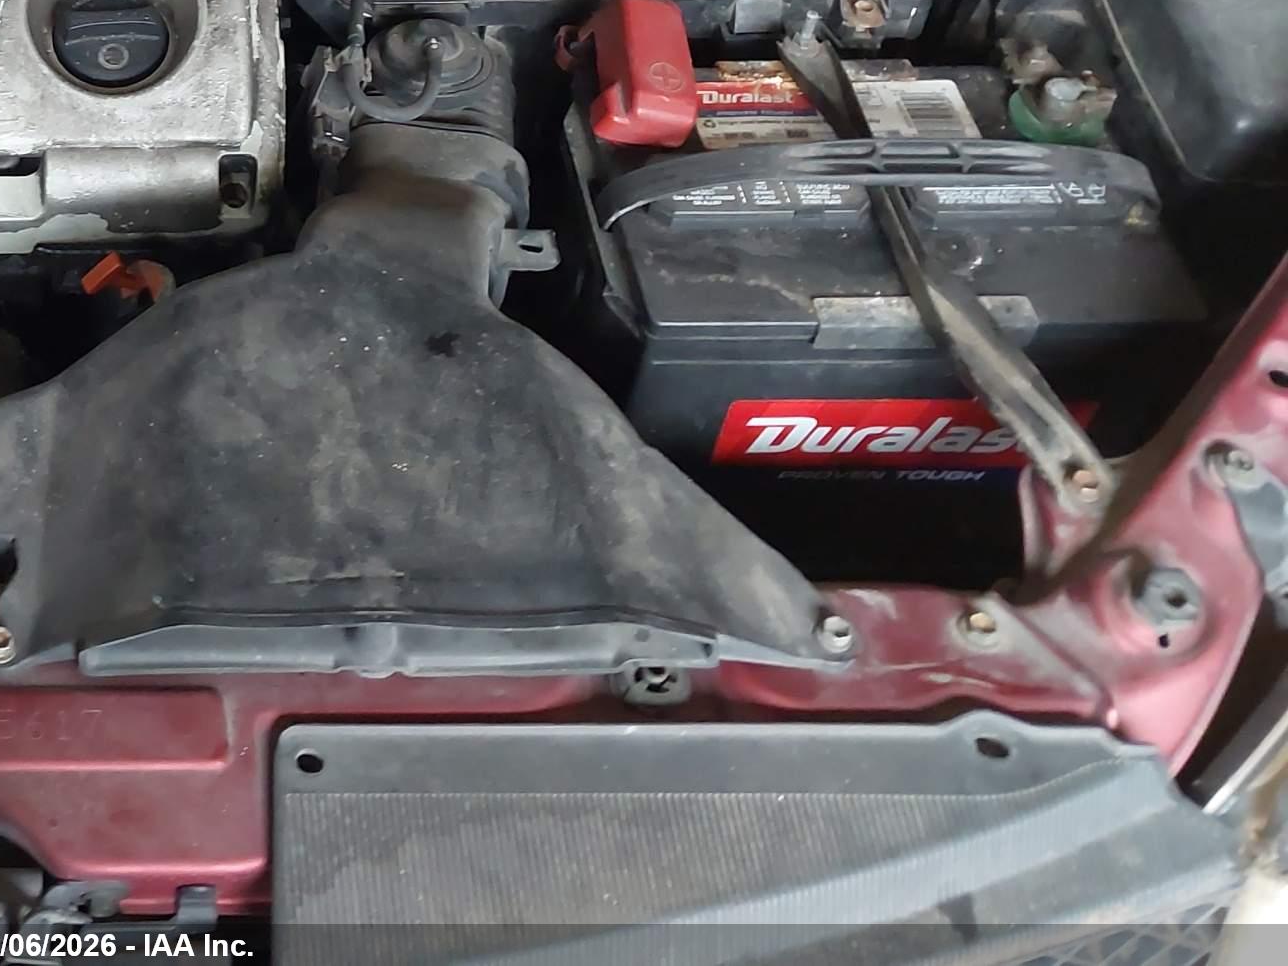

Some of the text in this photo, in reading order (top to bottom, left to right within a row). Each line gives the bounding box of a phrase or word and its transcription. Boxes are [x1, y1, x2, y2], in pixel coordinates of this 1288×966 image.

[696, 90, 795, 104] Duralast
[745, 416, 1028, 454] Duralas
[776, 469, 986, 481] PROVEN TOUGH
